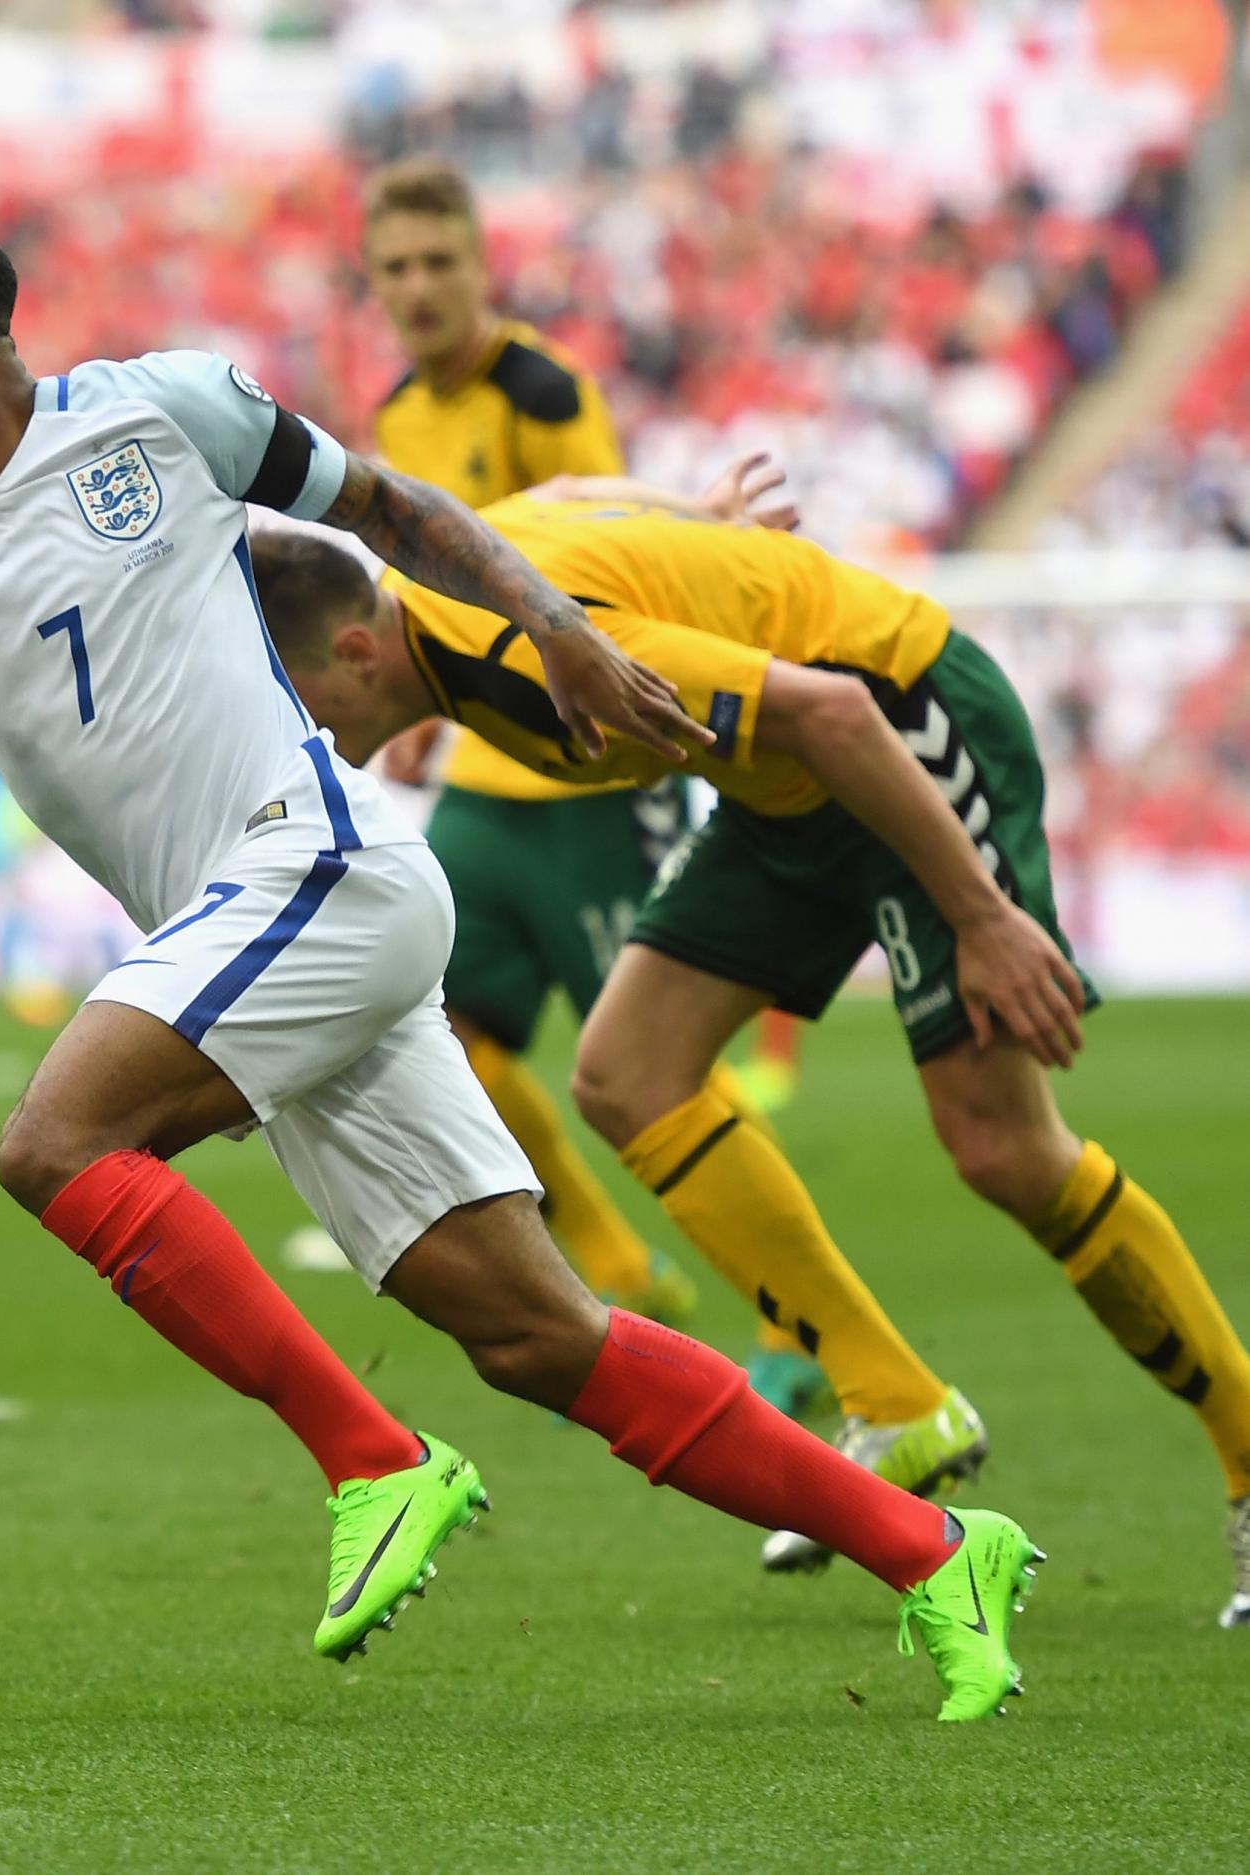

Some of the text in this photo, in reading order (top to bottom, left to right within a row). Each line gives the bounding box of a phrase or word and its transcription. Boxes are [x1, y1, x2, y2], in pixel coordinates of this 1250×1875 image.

[123, 562, 133, 573] 26
[132, 549, 161, 567] MARCH
[127, 538, 165, 560] LITHUANIA
[36, 605, 95, 725] 7
[144, 882, 246, 946] 7
[877, 897, 921, 992] 8
